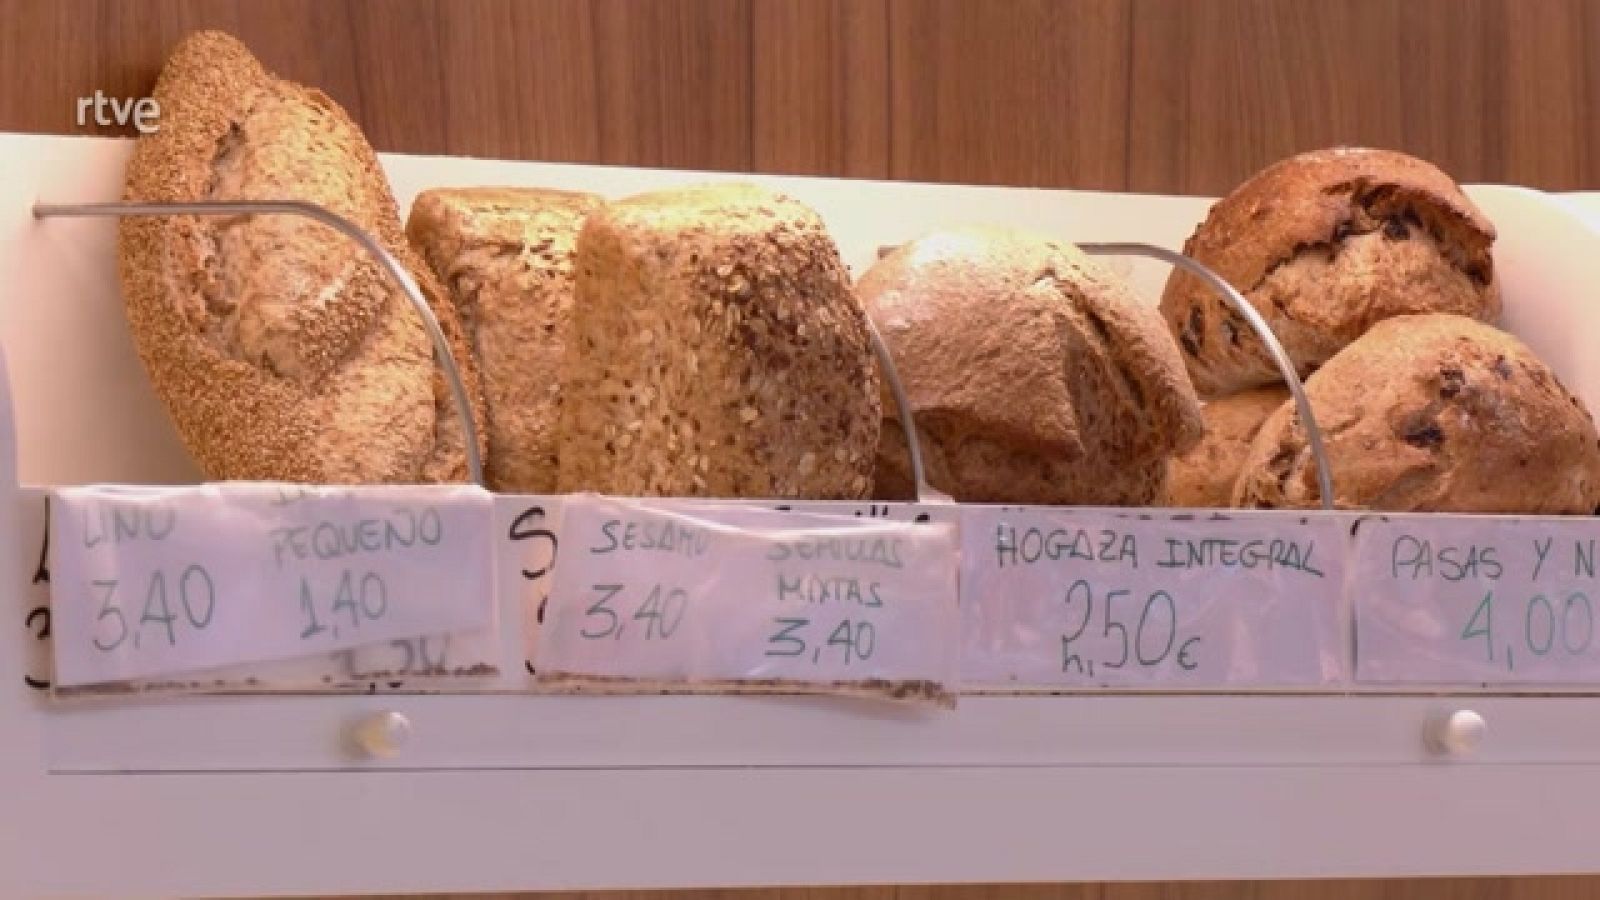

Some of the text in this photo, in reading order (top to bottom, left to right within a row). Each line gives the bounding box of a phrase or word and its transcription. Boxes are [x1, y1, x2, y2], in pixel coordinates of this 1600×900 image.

[996, 525, 1325, 577] HOGAZA INTEGRAL
[1392, 534, 1503, 580] PASAS
[1532, 537, 1552, 581] Y
[92, 564, 214, 651] 3,40
[300, 569, 387, 640] 1,40
[580, 584, 688, 640] 3,40
[778, 575, 883, 608] MIXTAS
[764, 617, 876, 665] 3,40
[1460, 590, 1593, 671] 4,00
